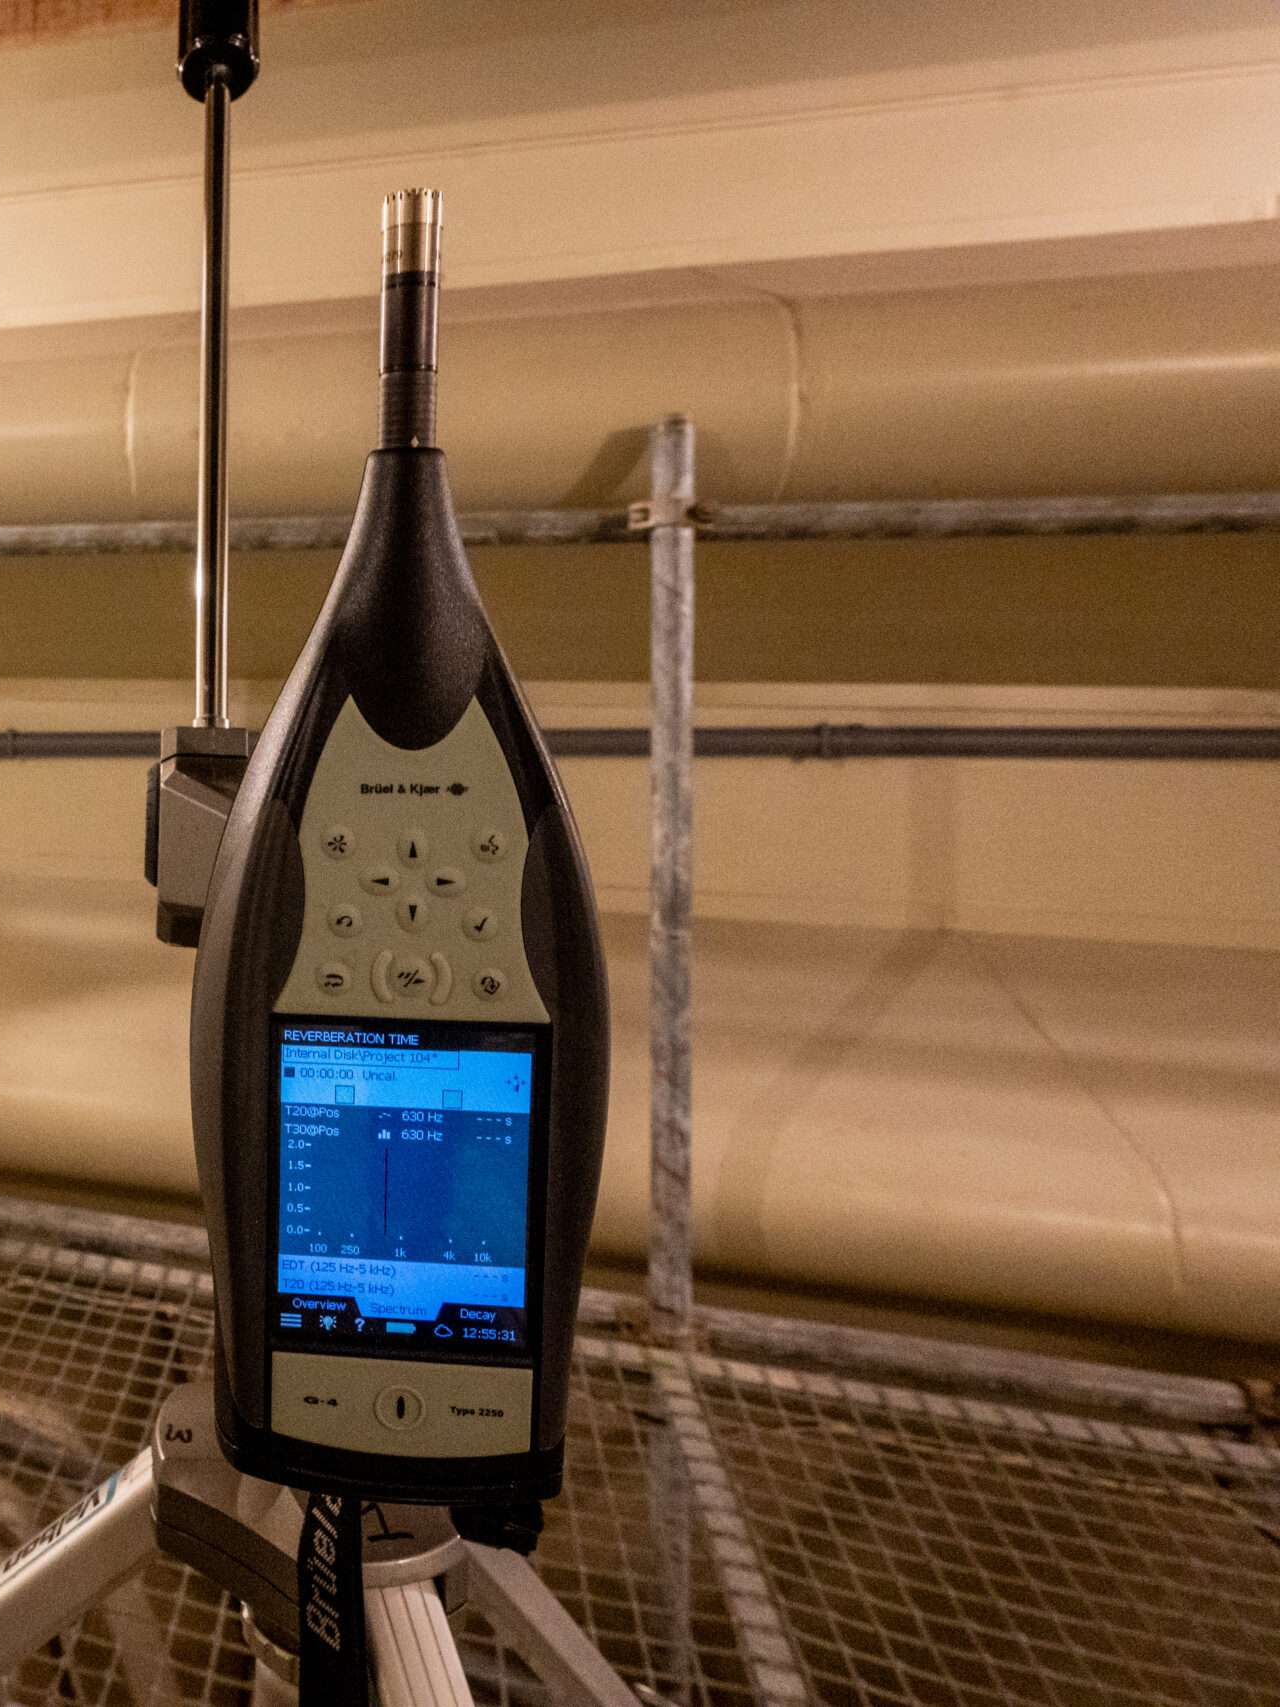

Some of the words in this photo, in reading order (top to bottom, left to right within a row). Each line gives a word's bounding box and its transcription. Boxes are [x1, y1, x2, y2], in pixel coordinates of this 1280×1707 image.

[360, 784, 393, 794] Brüel
[397, 784, 405, 794] &
[410, 784, 441, 797] Kjær
[284, 1030, 385, 1044] REVERBERATION
[389, 1035, 419, 1045] TIME
[284, 1048, 331, 1059] Internal
[300, 1067, 354, 1080] 00:00:00
[285, 1106, 340, 1119] T20@Pos
[402, 1111, 424, 1122] 630
[427, 1113, 443, 1122] Hz
[284, 1124, 340, 1137] T30@Pos
[401, 1130, 424, 1141] 630
[427, 1131, 443, 1141] Hz
[309, 1244, 328, 1254] 100
[340, 1245, 360, 1255] 250
[395, 1247, 407, 1258] 1k
[444, 1251, 455, 1261] 4k
[474, 1252, 492, 1263] 10k
[310, 1262, 337, 1274] (125
[309, 1280, 336, 1292] (125
[292, 1298, 347, 1312] Overview
[370, 1303, 427, 1316] Spectrum
[460, 1308, 496, 1321] Decay
[462, 1327, 516, 1341] 12:55:31
[449, 1405, 475, 1416] Type
[478, 1407, 504, 1418] 2250
[1, 1488, 101, 1573] Velbon
